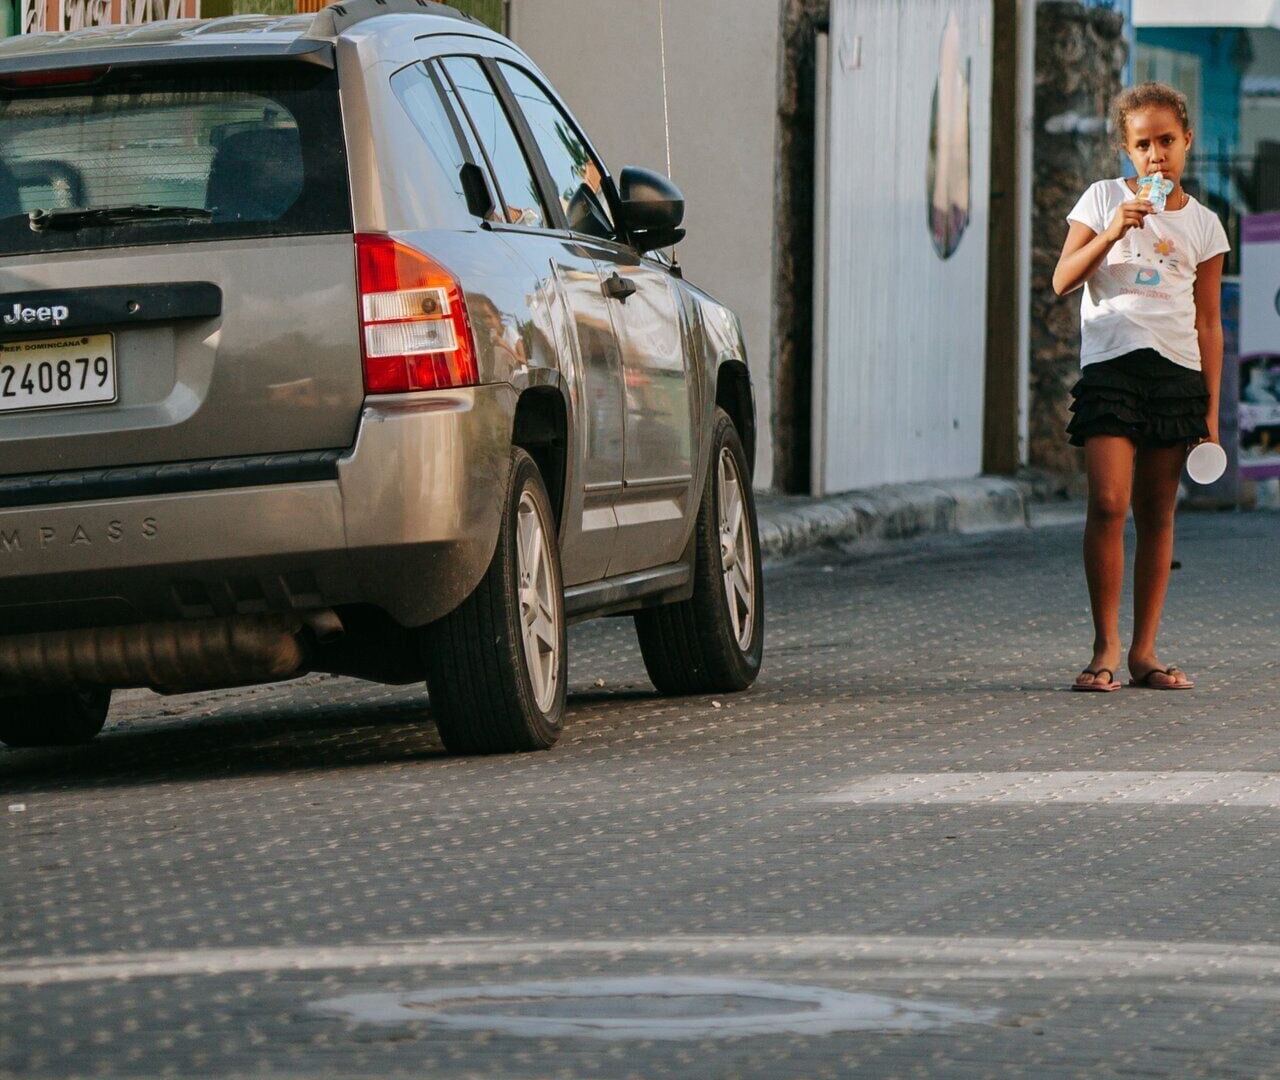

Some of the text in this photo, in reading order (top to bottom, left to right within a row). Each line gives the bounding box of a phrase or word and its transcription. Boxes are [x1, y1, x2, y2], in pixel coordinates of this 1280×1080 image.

[3, 303, 69, 326] Jeep
[25, 340, 81, 352] DOMINICANA
[1, 356, 108, 397] 240879
